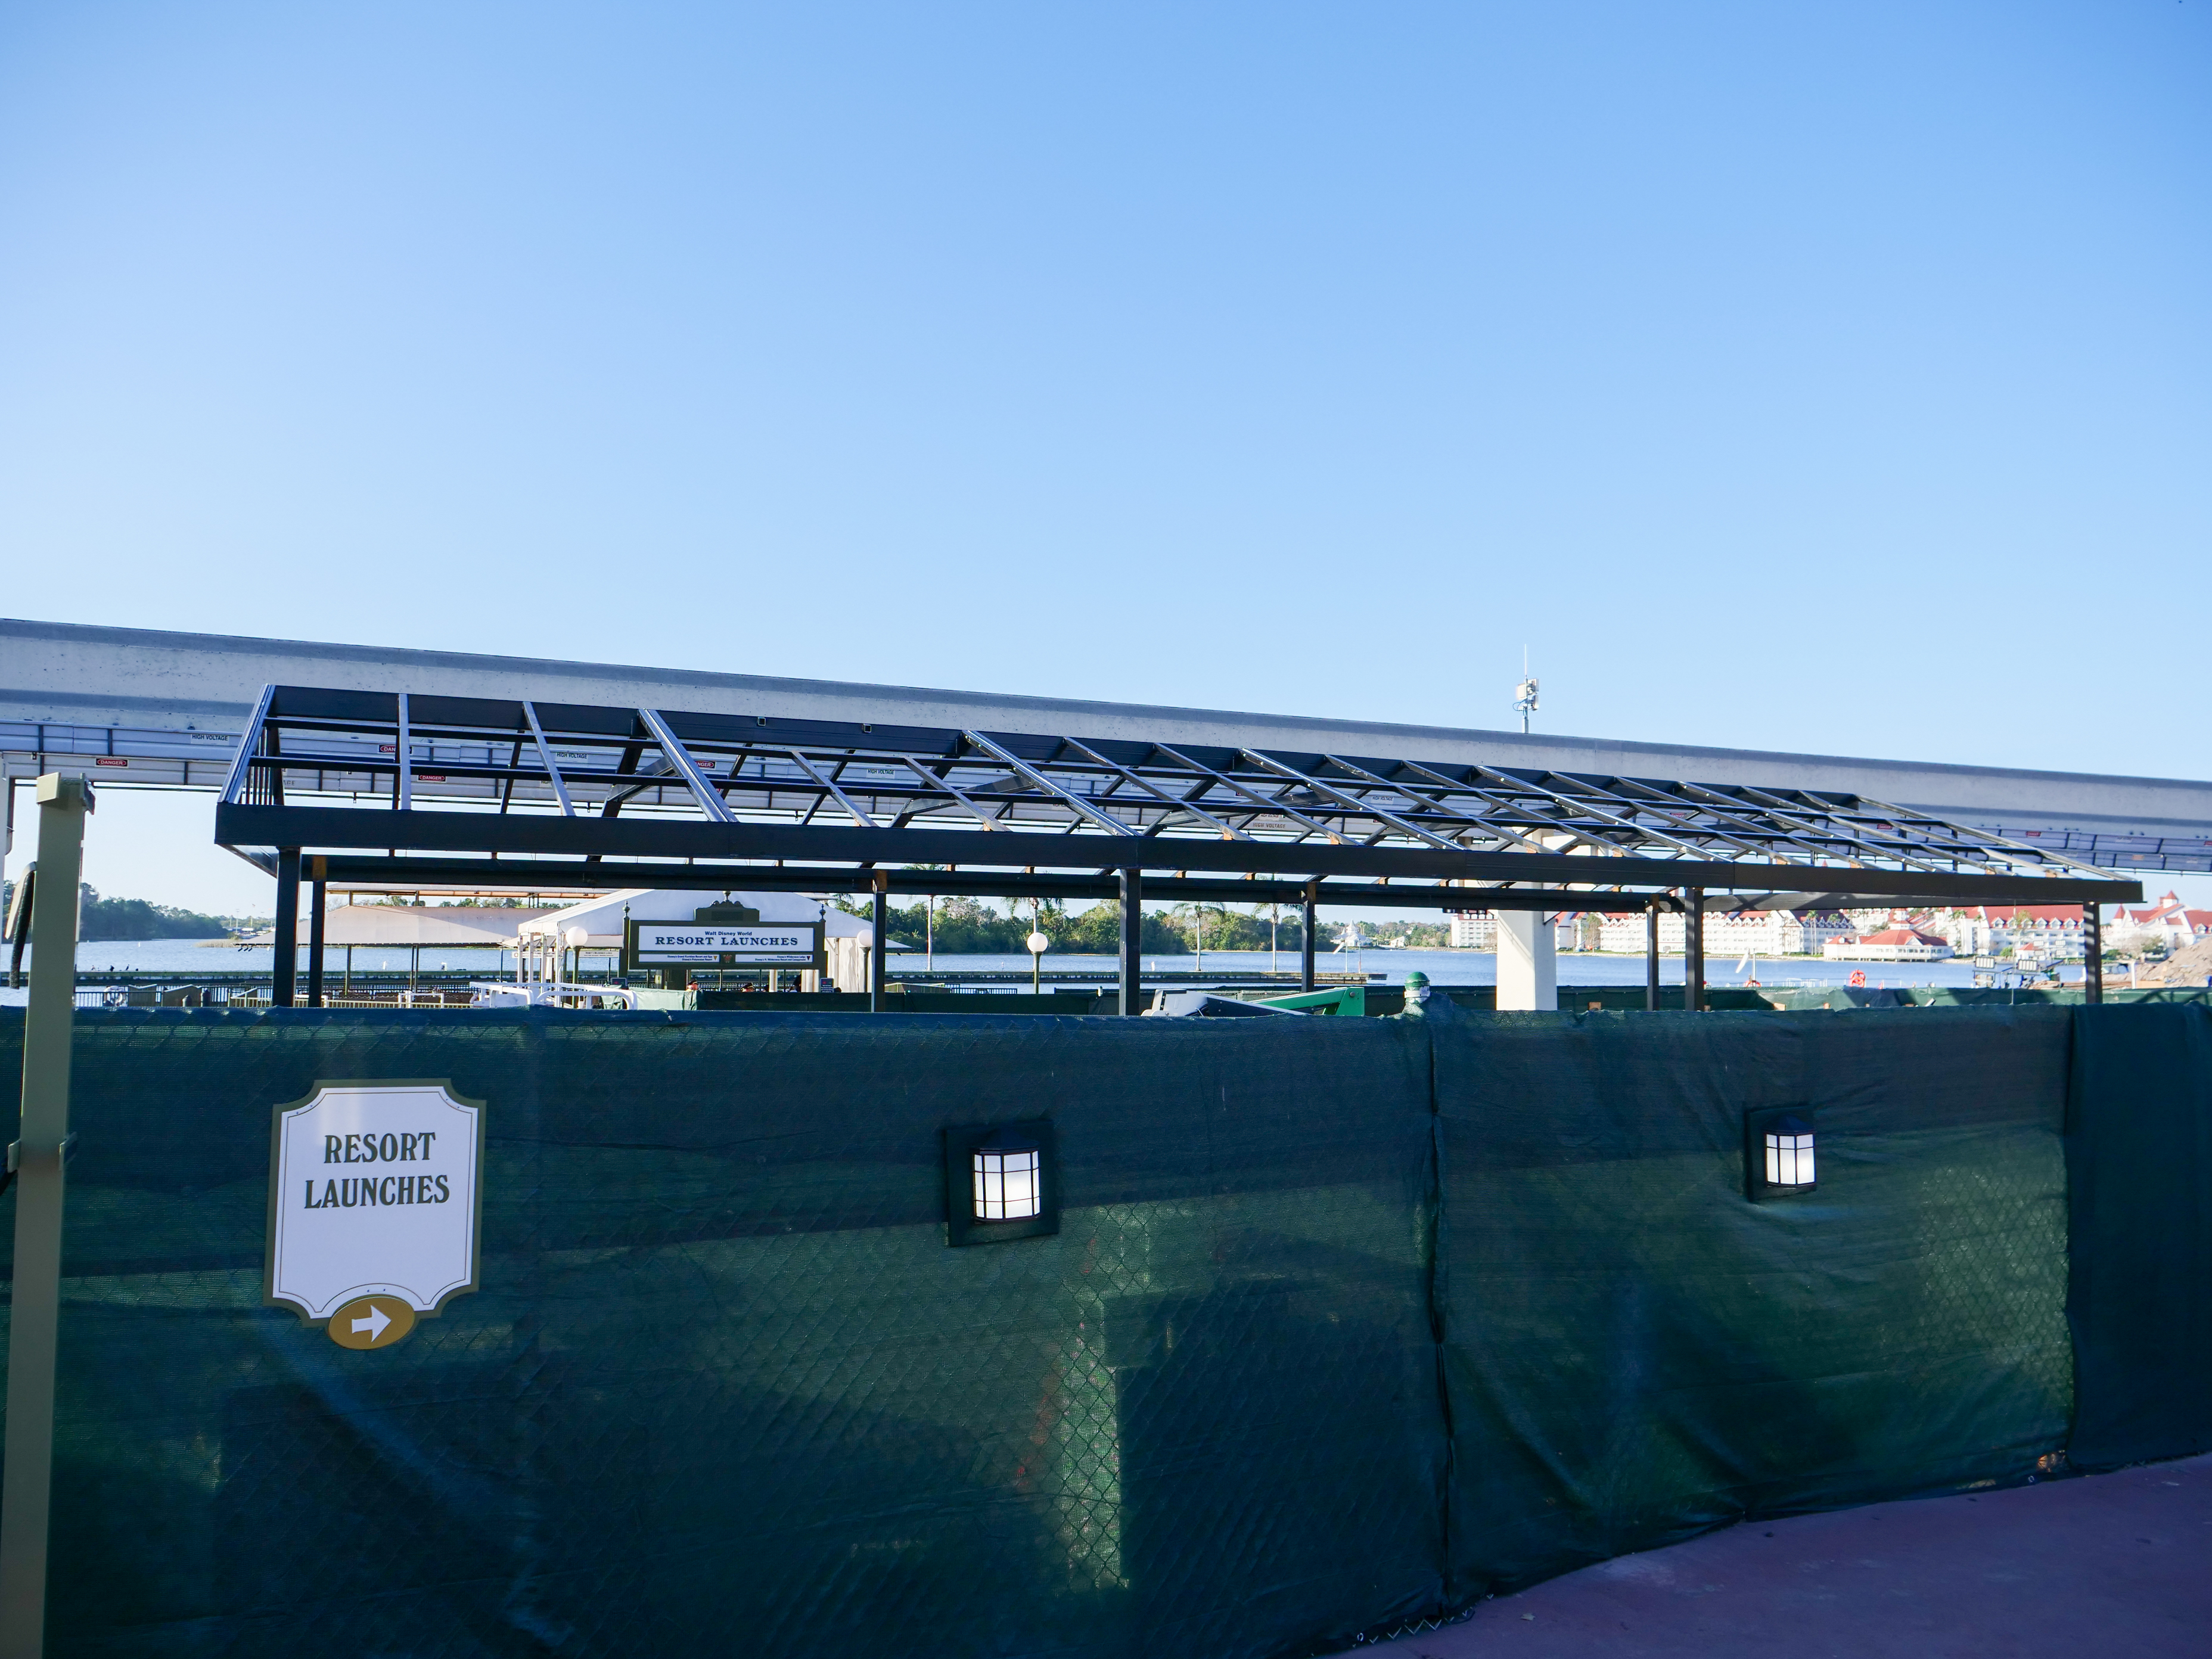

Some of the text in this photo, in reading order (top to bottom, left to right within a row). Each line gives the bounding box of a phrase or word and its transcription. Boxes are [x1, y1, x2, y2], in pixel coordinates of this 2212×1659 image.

[655, 937, 799, 946] RESORT LAUNCHES
[324, 1132, 436, 1164] RESORT
[304, 1174, 450, 1209] LAUNCHES
